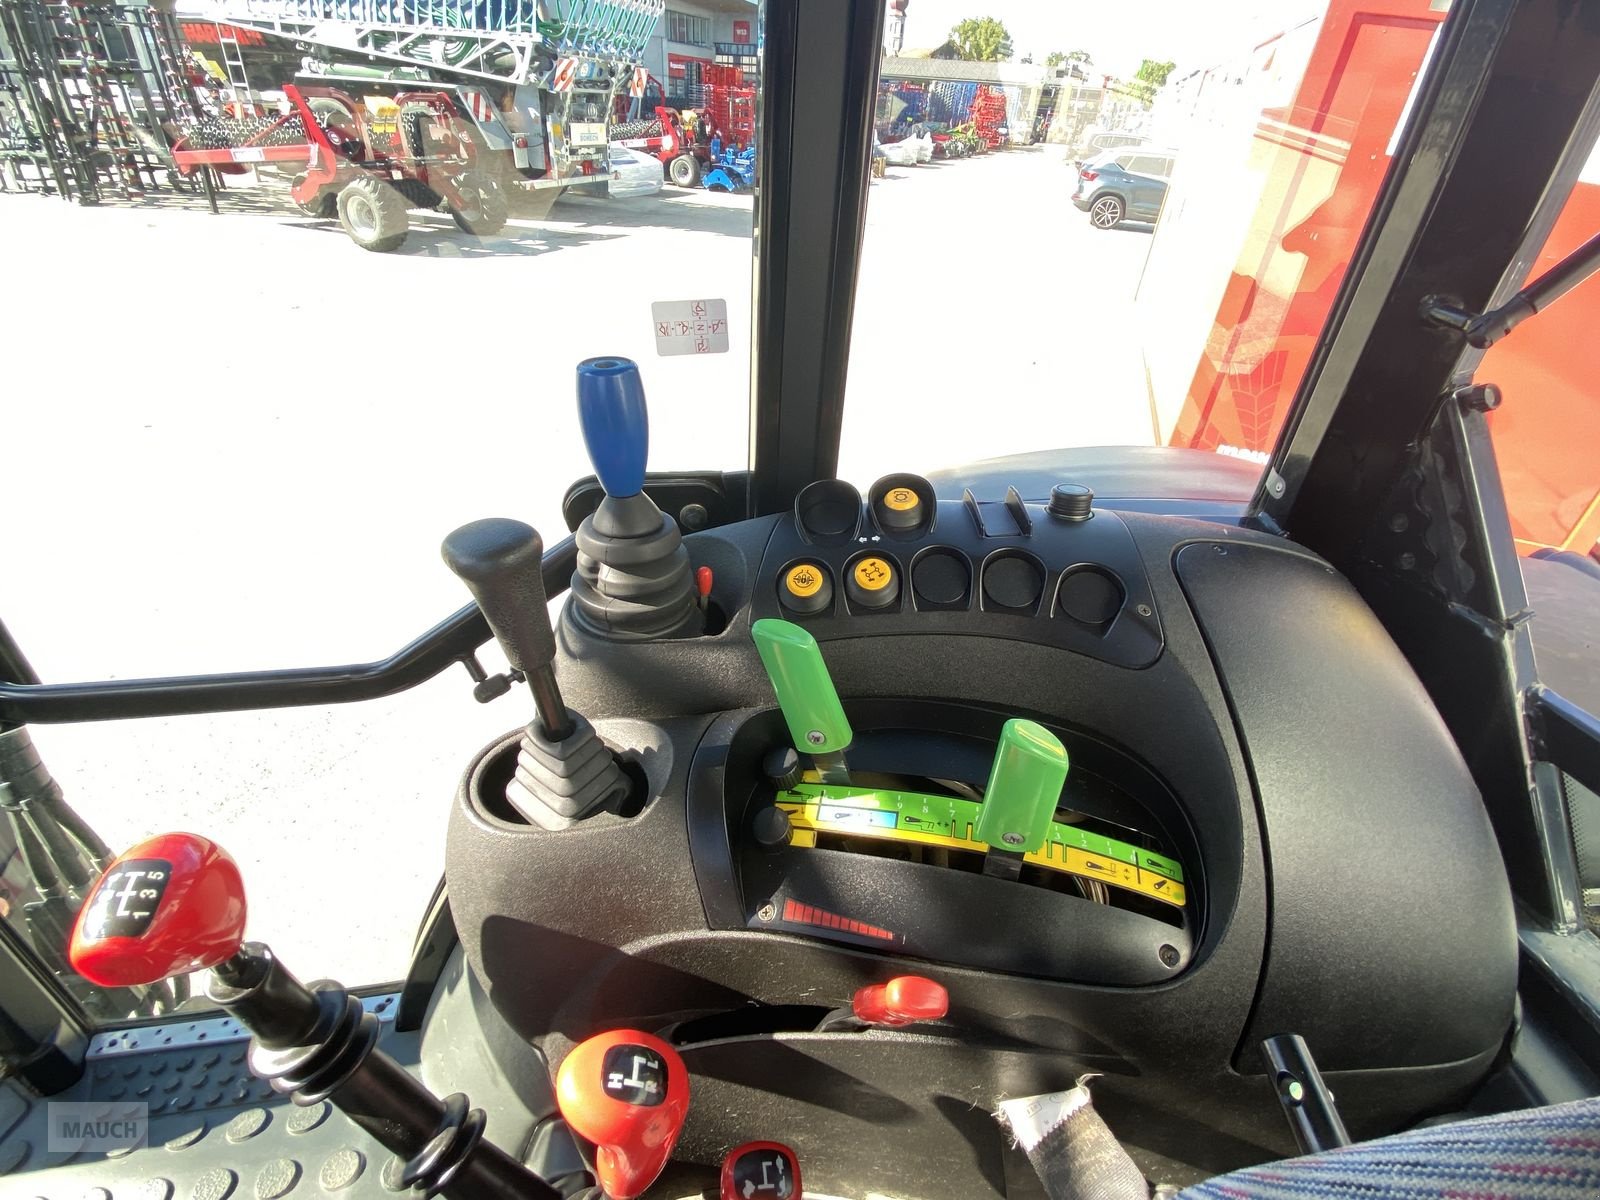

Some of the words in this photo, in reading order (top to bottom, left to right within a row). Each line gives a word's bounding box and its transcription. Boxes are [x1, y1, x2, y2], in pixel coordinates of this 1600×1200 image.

[147, 871, 165, 880] 5
[139, 888, 158, 899] 3
[607, 1073, 623, 1088] H
